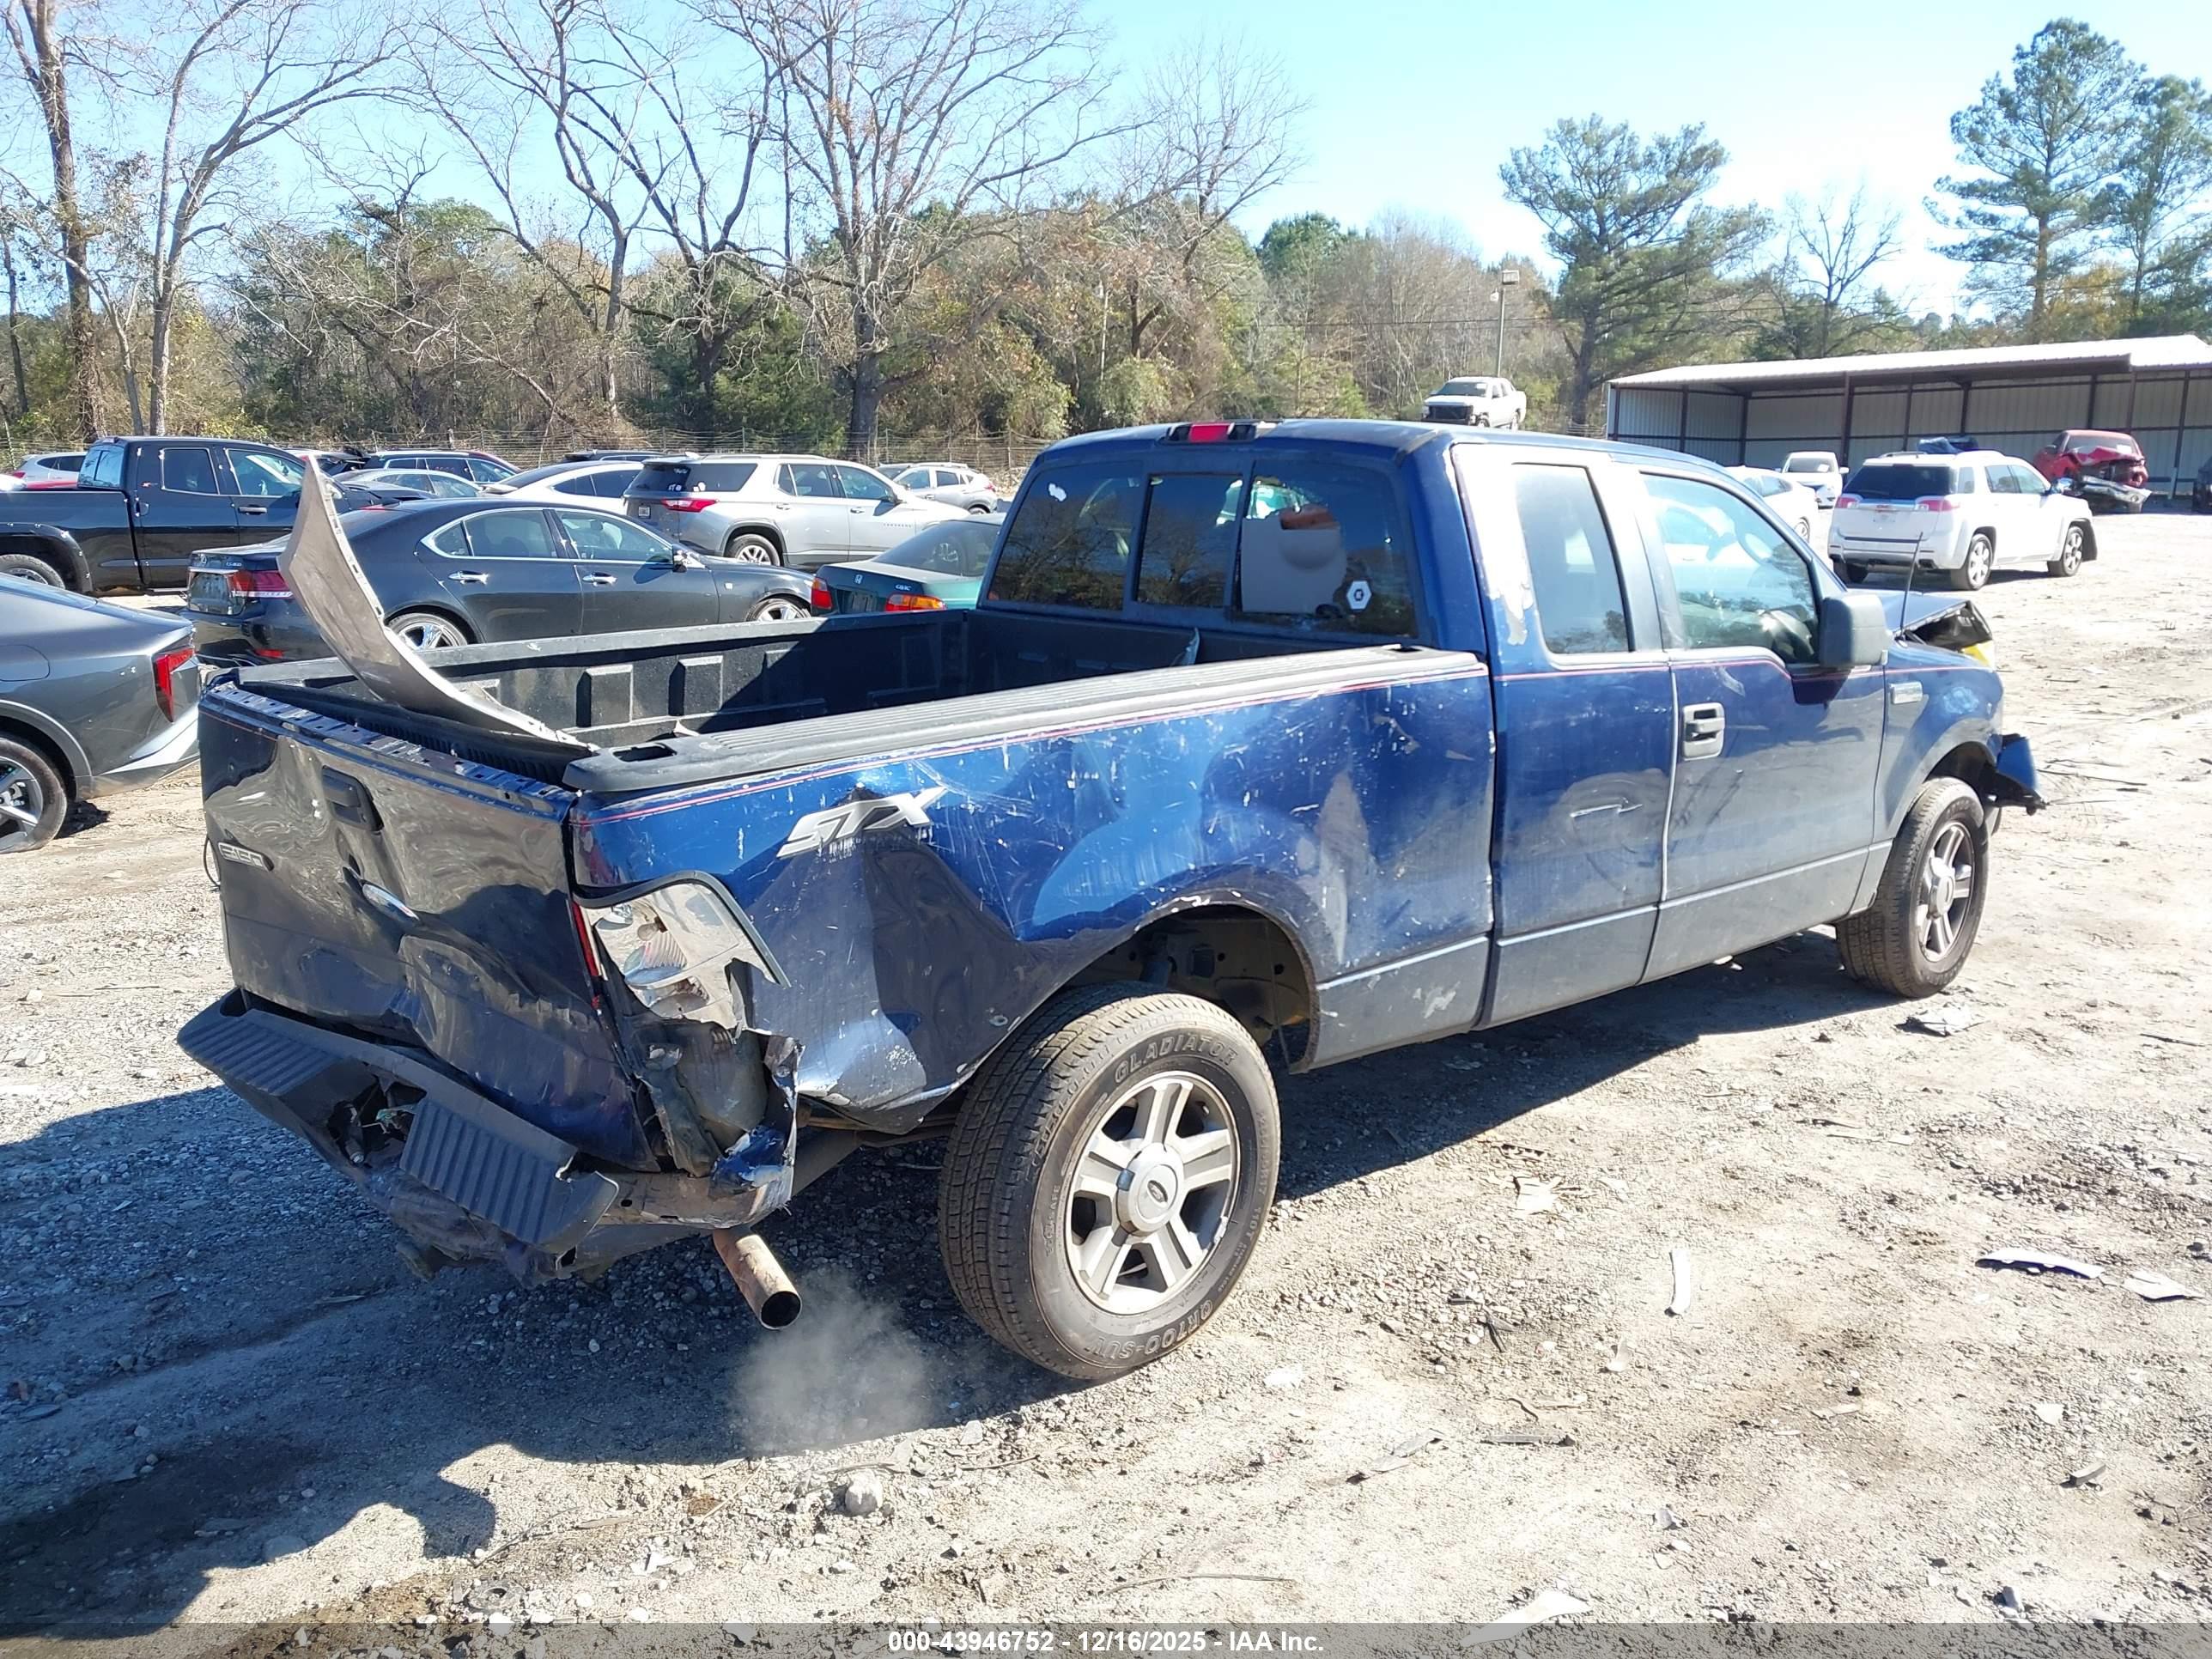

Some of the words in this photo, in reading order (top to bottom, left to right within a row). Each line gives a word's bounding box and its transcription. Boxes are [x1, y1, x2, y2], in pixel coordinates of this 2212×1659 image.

[776, 786, 947, 859] STX
[1115, 1033, 1238, 1083] GLADIATOR
[1084, 1299, 1213, 1360] QR700-SUV
